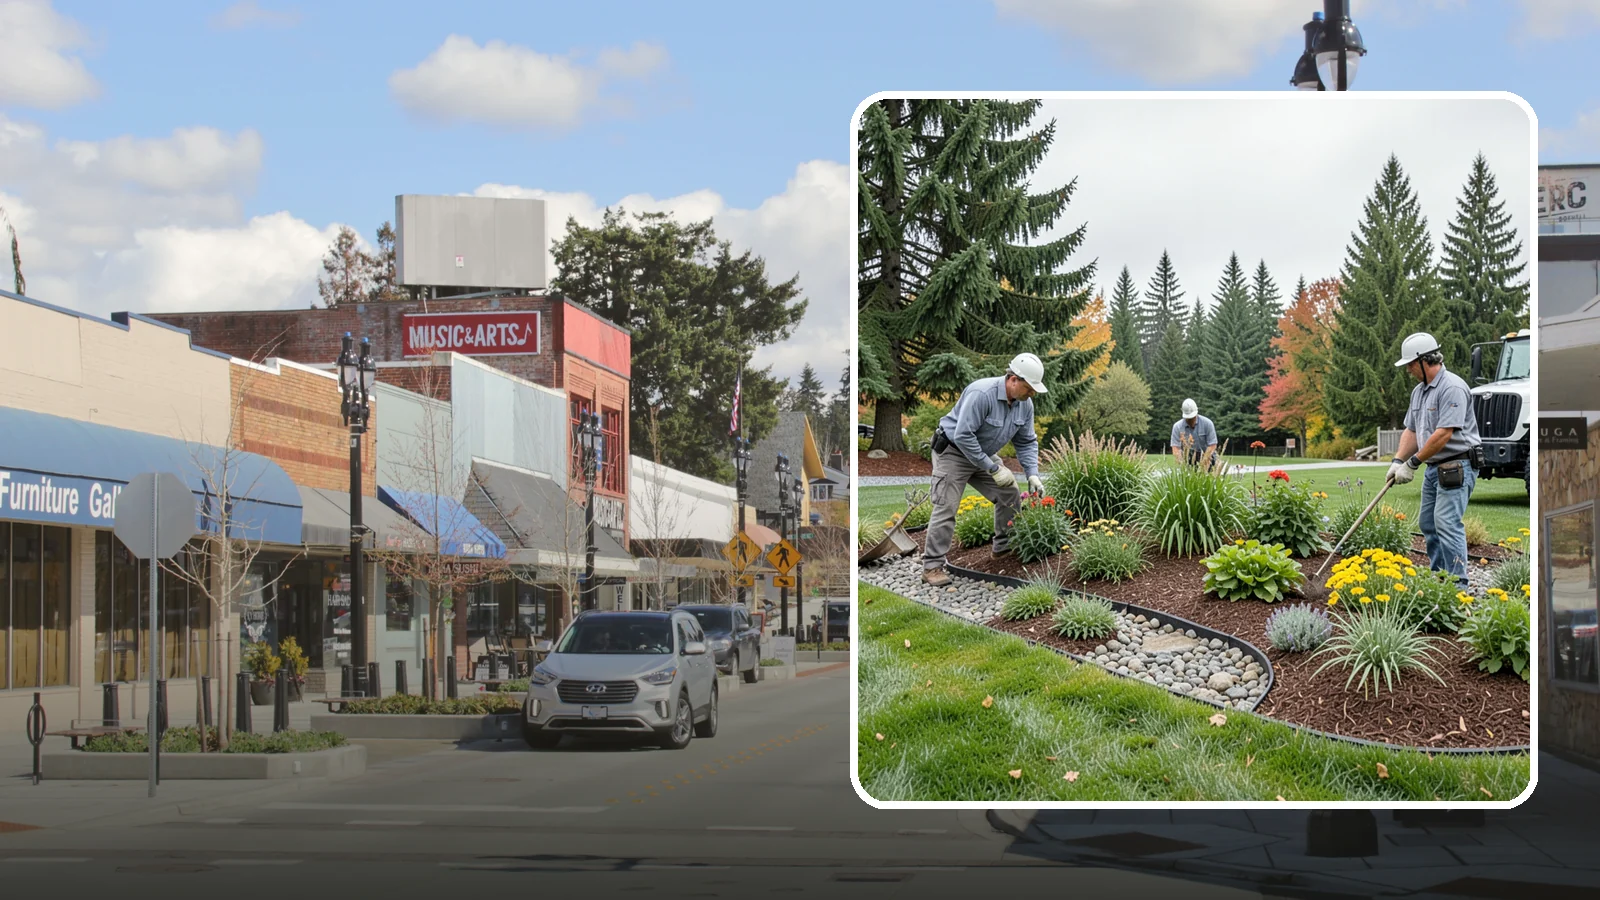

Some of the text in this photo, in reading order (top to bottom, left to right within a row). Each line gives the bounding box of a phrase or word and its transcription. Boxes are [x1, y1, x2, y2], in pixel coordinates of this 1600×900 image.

[409, 324, 519, 348] MUSIC&ARTS
[0, 471, 122, 519] Furniture Gal
[453, 563, 480, 574] SUSHI
